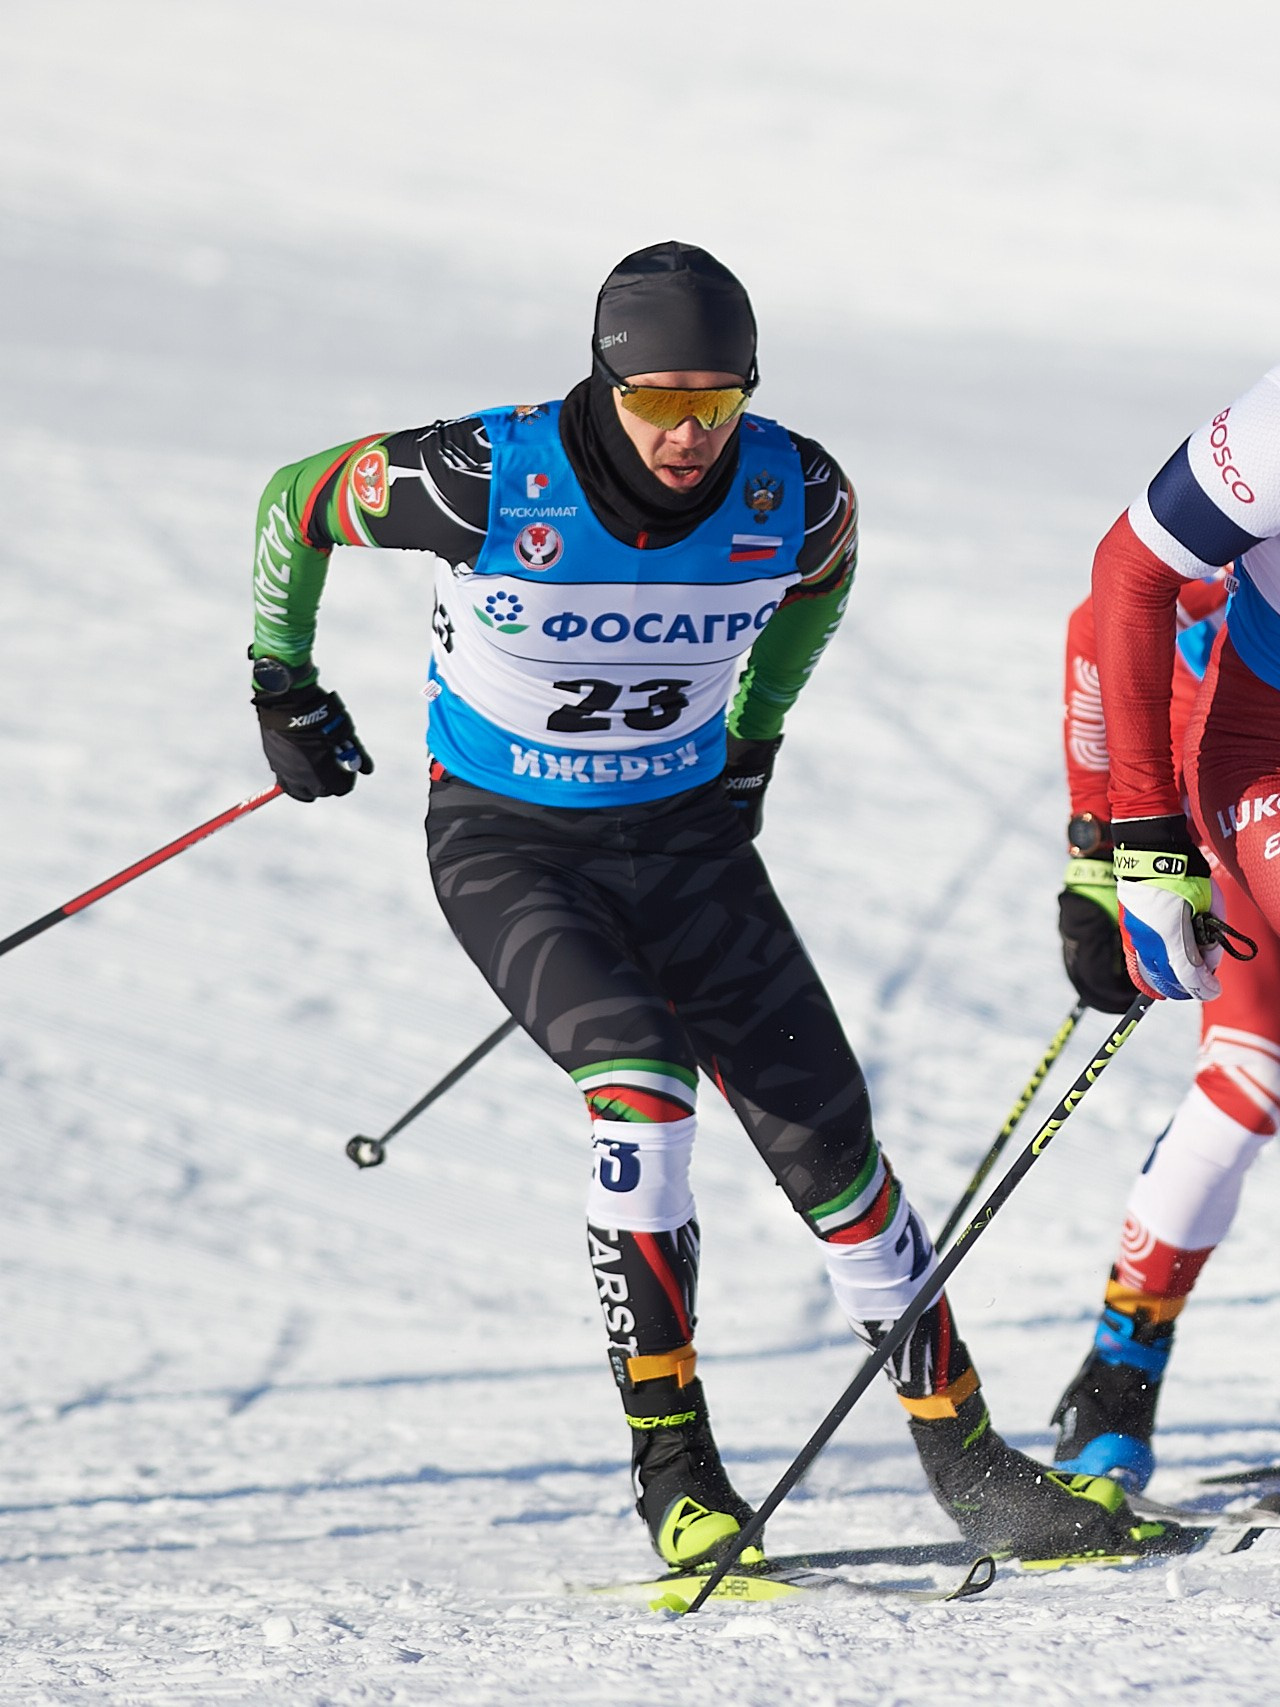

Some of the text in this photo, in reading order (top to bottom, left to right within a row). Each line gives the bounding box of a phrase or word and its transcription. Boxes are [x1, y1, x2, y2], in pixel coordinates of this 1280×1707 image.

[1210, 407, 1255, 504] BOSCO
[500, 506, 578, 518] РУСКЛИМАТ
[546, 679, 693, 732] 23
[592, 1133, 641, 1193] 3
